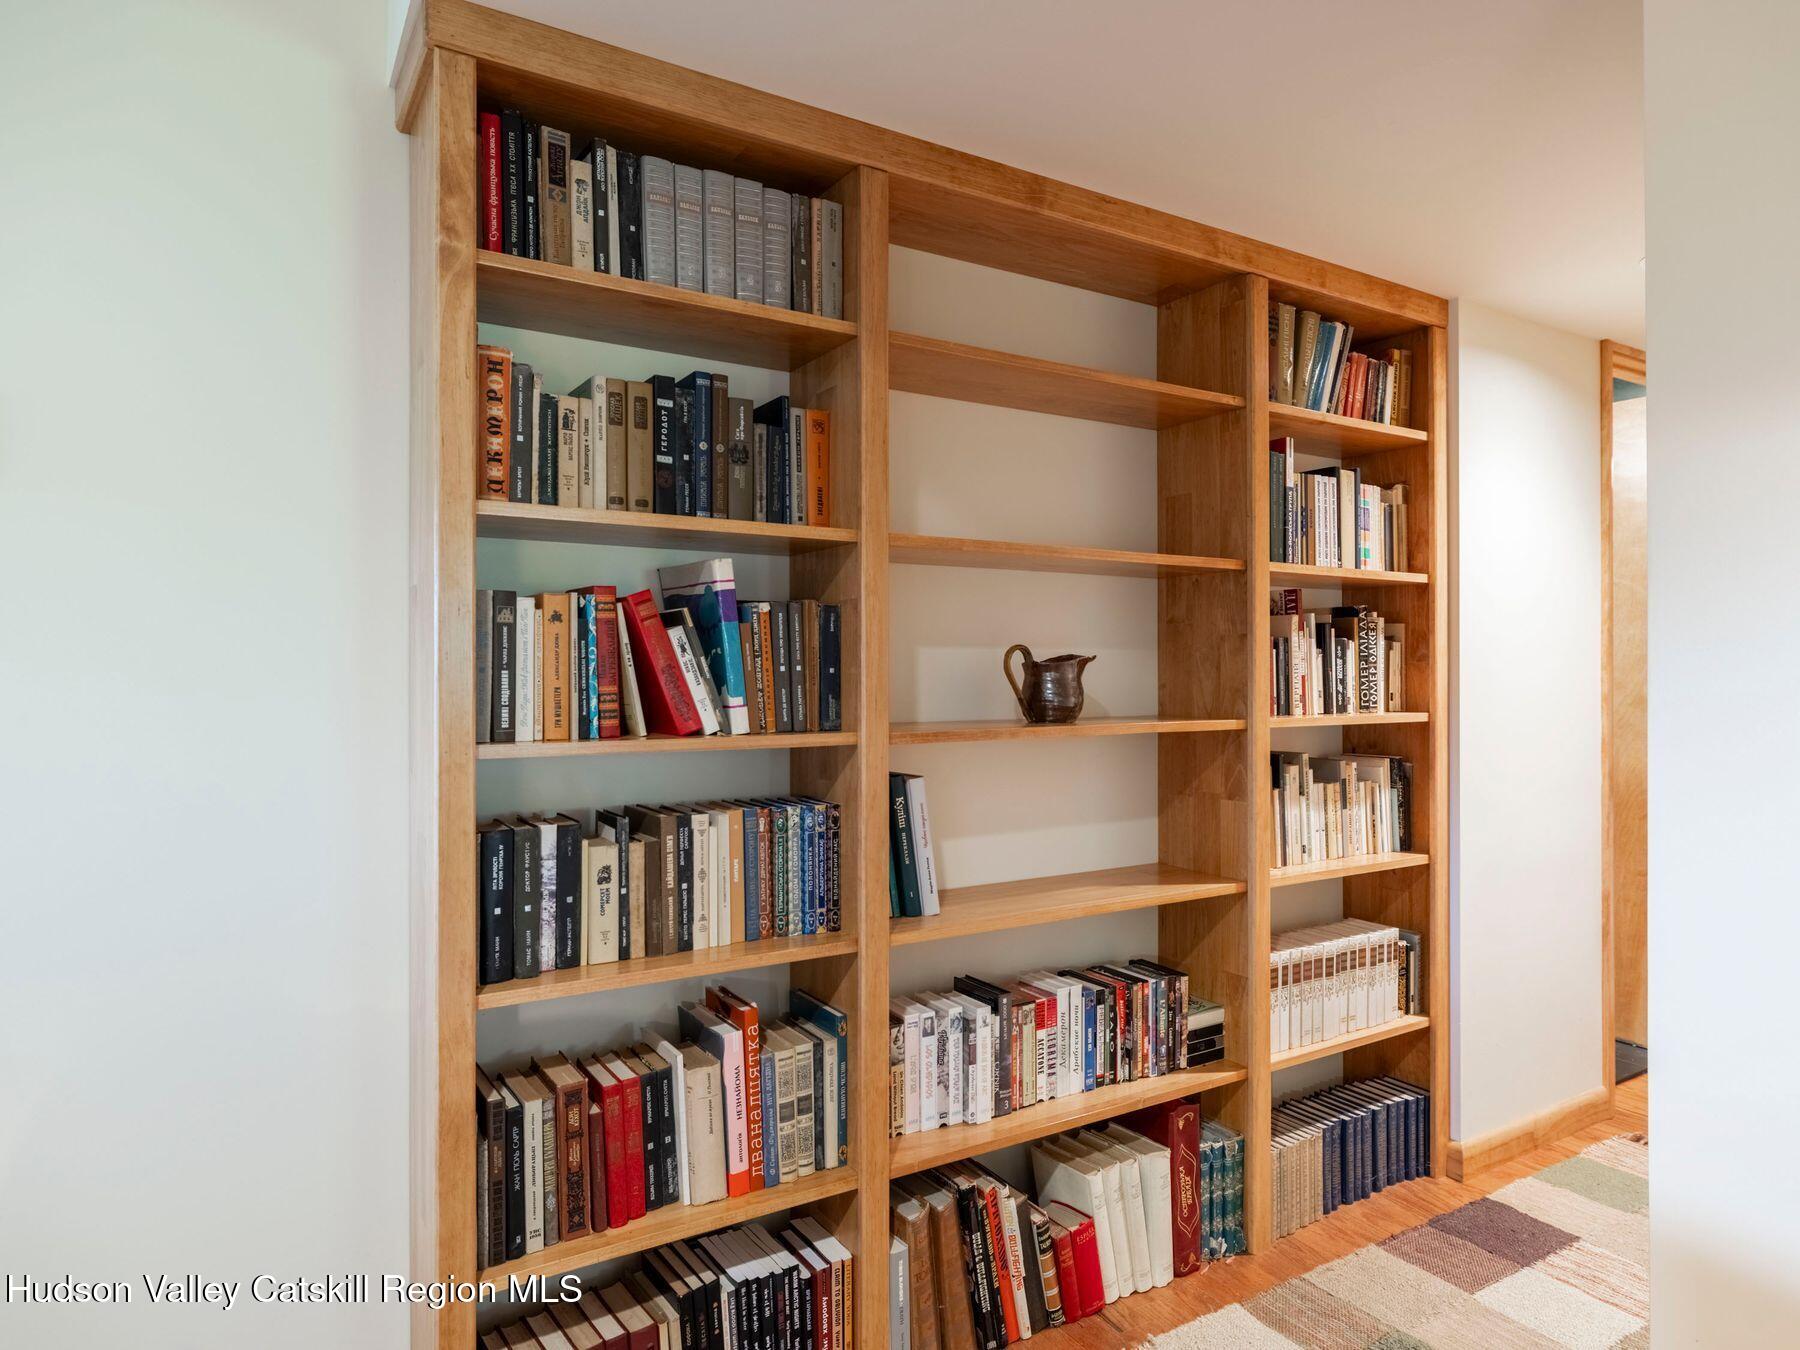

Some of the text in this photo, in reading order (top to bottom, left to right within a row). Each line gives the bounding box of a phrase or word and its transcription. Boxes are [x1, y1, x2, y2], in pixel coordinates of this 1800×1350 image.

[487, 127, 498, 241] Сучасна французька повість
[486, 358, 505, 494] ДЕКАМЕРОН
[660, 409, 668, 452] ГЕРОДОТ
[1360, 611, 1368, 656] ІЛІАДА
[501, 670, 510, 705] СПОДІВАННЯ
[1369, 667, 1377, 707] ГОМЕР
[554, 719, 562, 728] ТРИ
[894, 796, 907, 828] Куліш
[666, 853, 674, 888] КАЙДАШЕВА
[1037, 1039, 1045, 1075] ACCATONE
[1047, 1032, 1056, 1077] TEOREMA
[734, 1065, 743, 1120] НЕЗНАЙОМА
[747, 1023, 765, 1177] дванадцятка
[1008, 1234, 1023, 1291] BULLFIGHTING
[976, 1262, 990, 1313] BULLFIGHTING
